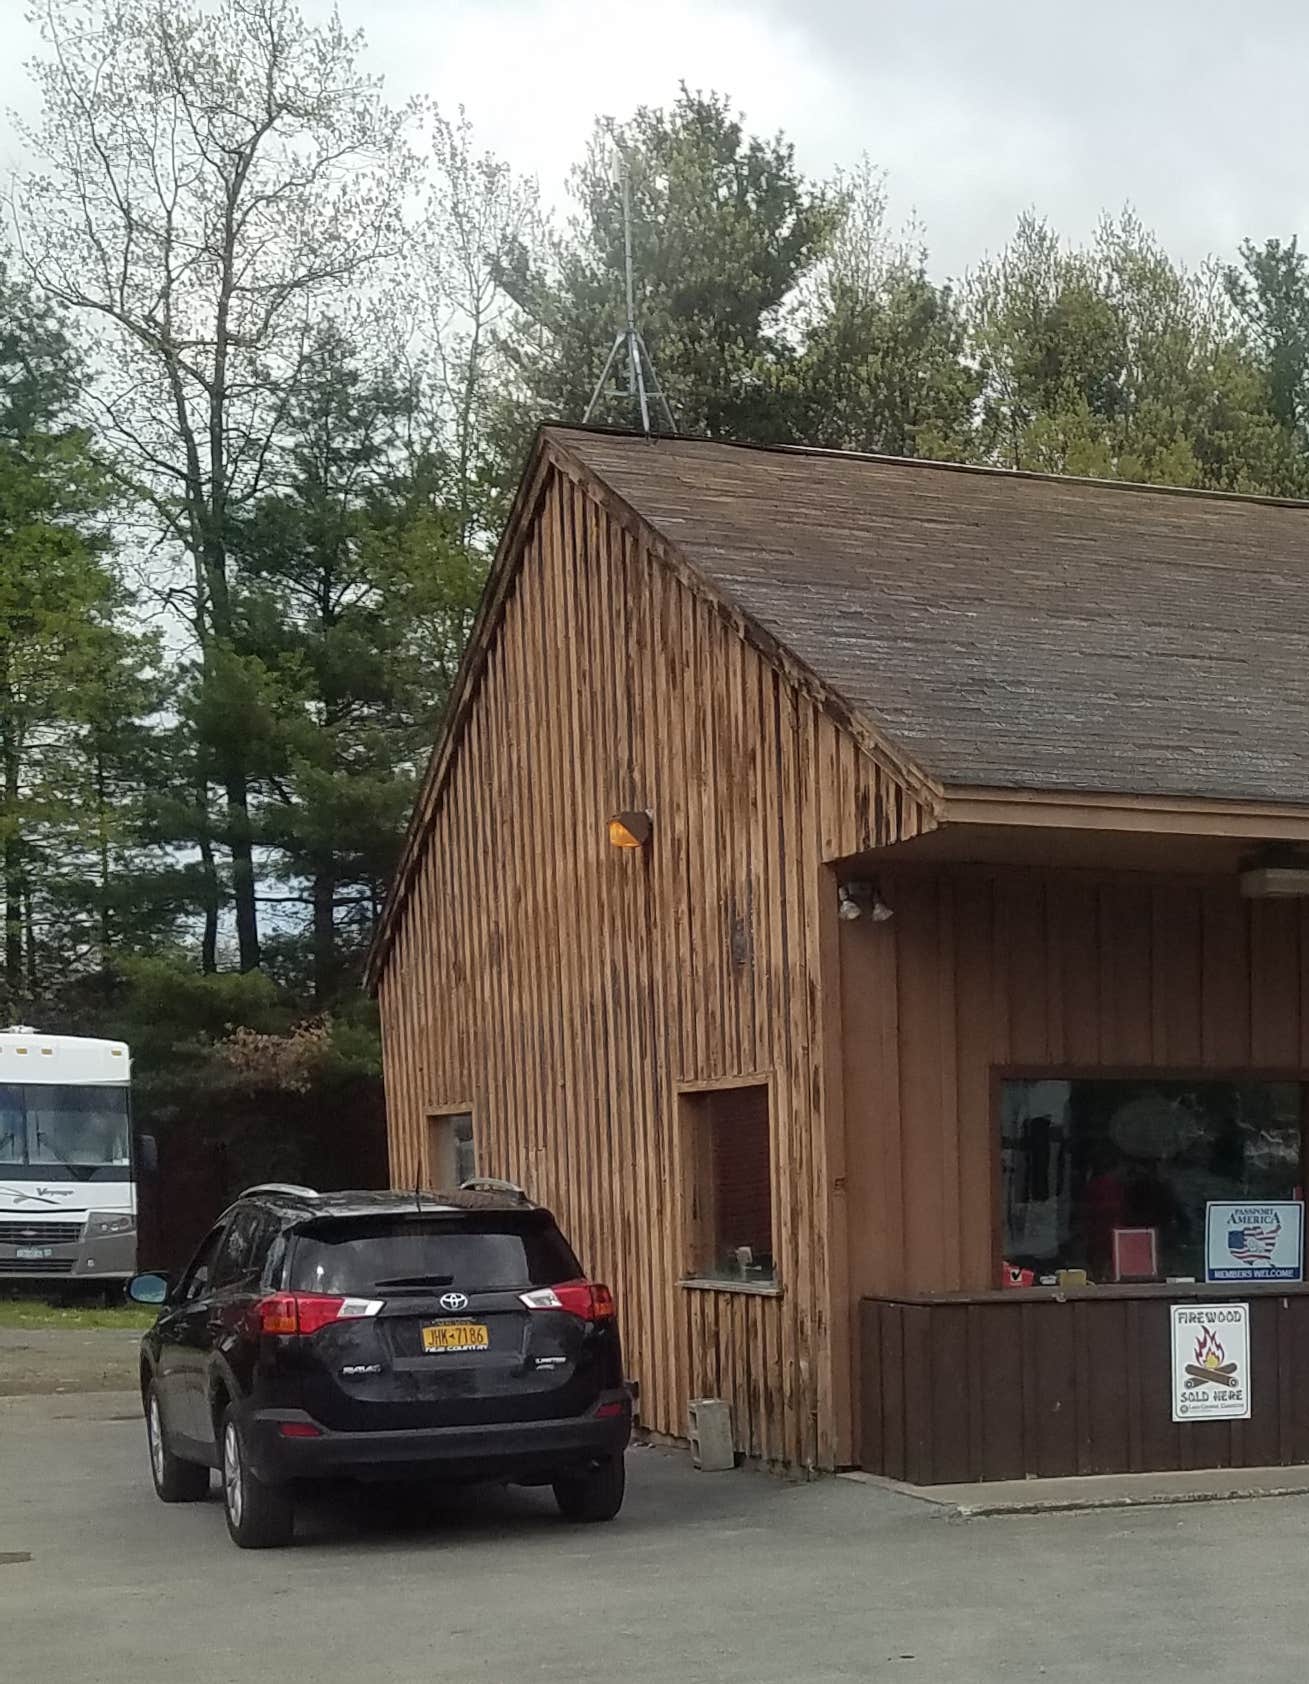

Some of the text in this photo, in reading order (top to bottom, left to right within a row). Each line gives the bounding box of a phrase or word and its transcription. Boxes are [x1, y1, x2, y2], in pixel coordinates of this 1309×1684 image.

[1226, 1211, 1281, 1225] AMERICA
[1214, 1269, 1294, 1279] MEMBERS WELCOME
[1178, 1310, 1242, 1324] FIREWOOD
[1180, 1389, 1243, 1403] SOLD HERE
